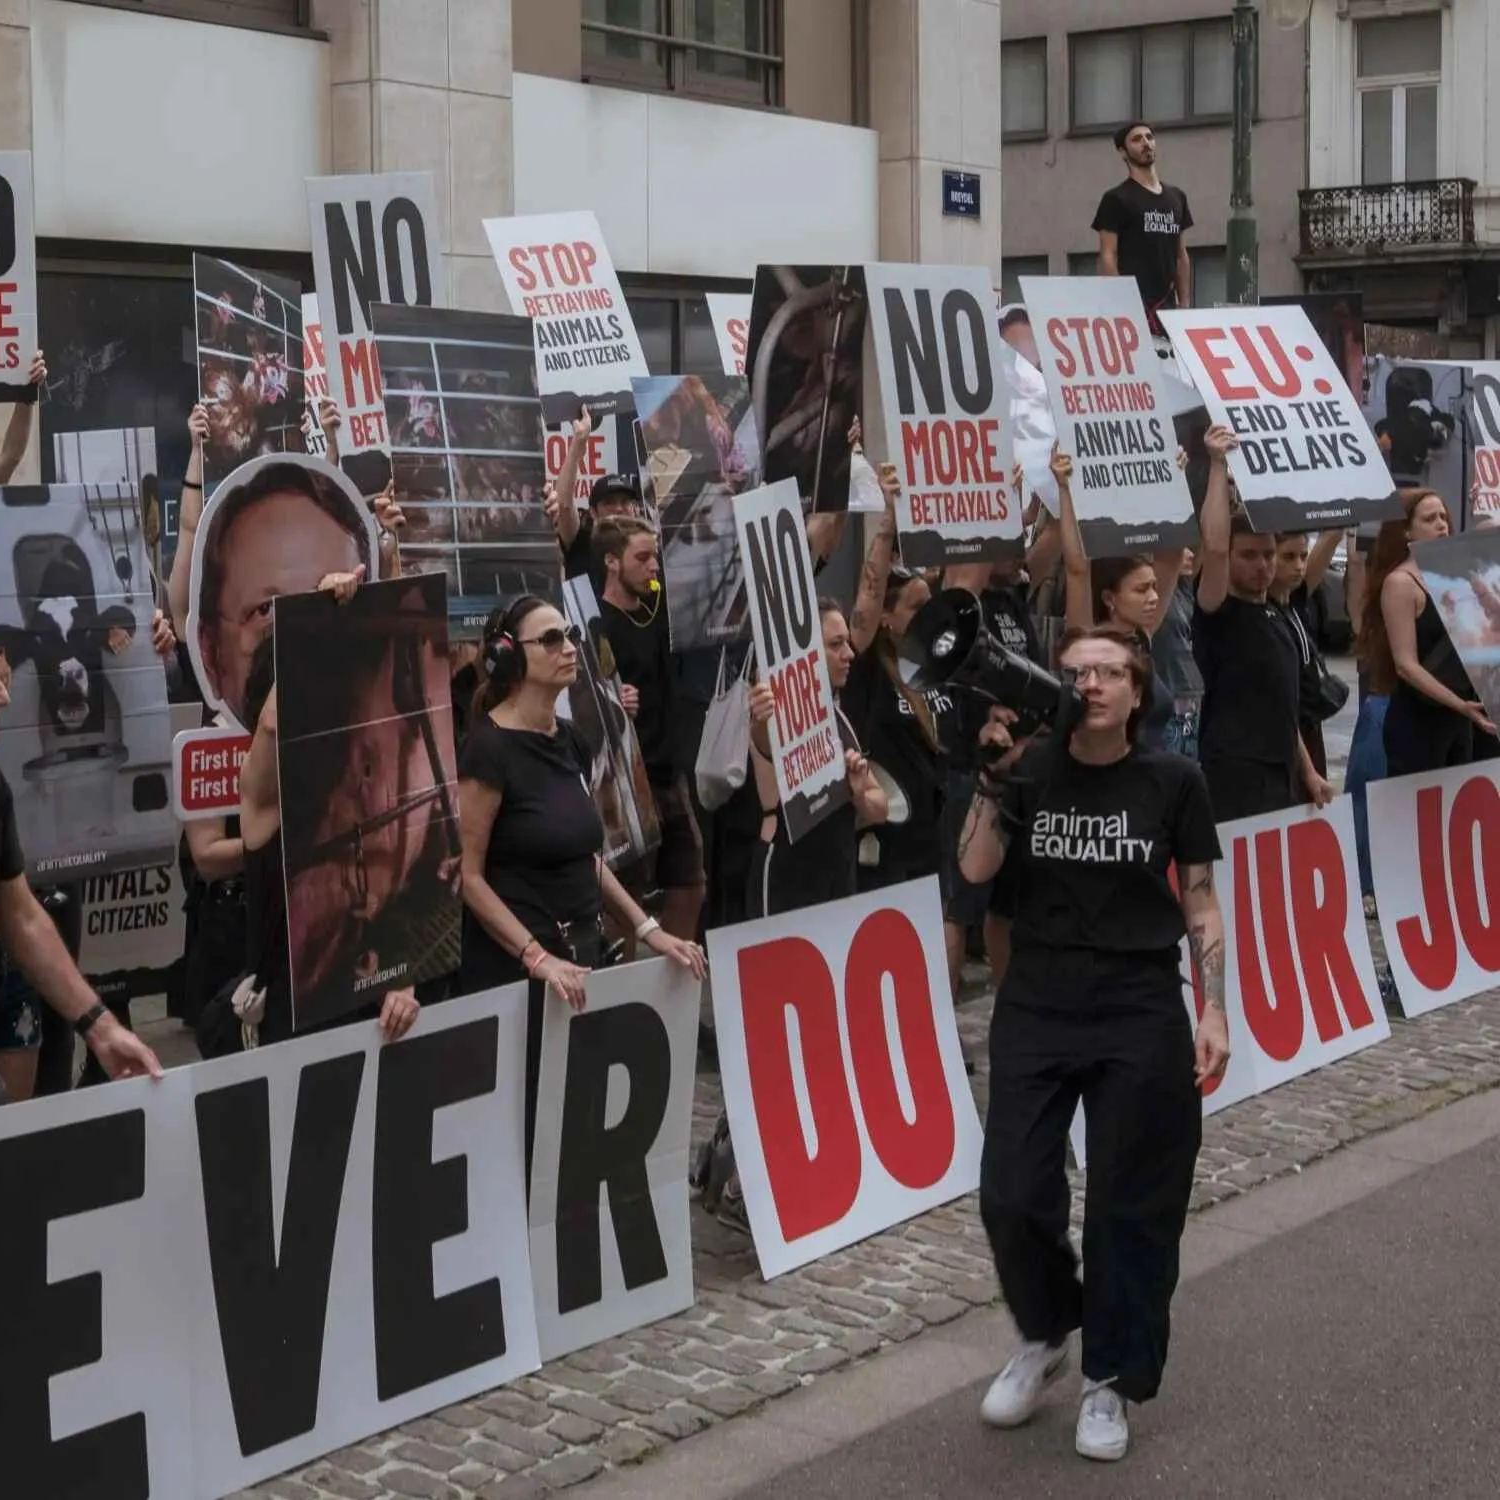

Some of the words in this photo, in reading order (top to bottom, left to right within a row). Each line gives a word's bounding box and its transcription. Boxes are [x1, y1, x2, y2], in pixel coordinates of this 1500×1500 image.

[1144, 209, 1174, 224] animal
[1144, 222, 1180, 234] EQUALITY
[324, 197, 431, 335] NO
[509, 241, 597, 291] STOP
[523, 288, 614, 318] BETRAYING
[535, 314, 624, 349] ANIMALS
[1047, 317, 1139, 378] STOP
[544, 354, 572, 372] AND
[572, 344, 631, 368] CITIZENS
[883, 288, 994, 415] NO
[1184, 325, 1333, 401] EU:
[1061, 381, 1156, 415] BETRAYING
[1225, 404, 1288, 434] END
[1287, 400, 1350, 430] THE
[901, 419, 1004, 486] MORE
[1073, 418, 1165, 458] ANIMALS
[1238, 432, 1367, 475] DELAYS
[1081, 463, 1111, 490] AND
[1111, 459, 1172, 487] CITIZENS
[910, 489, 1008, 525] BETRAYALS
[746, 508, 812, 667] NO
[770, 650, 827, 747] MORE
[191, 749, 228, 772] First
[780, 727, 835, 790] BETRAYALS
[191, 776, 228, 800] First
[1032, 807, 1128, 838] animal
[1031, 834, 1153, 863] EQUALITY
[87, 902, 169, 936] CITIZENS
[738, 907, 956, 1242] DO
